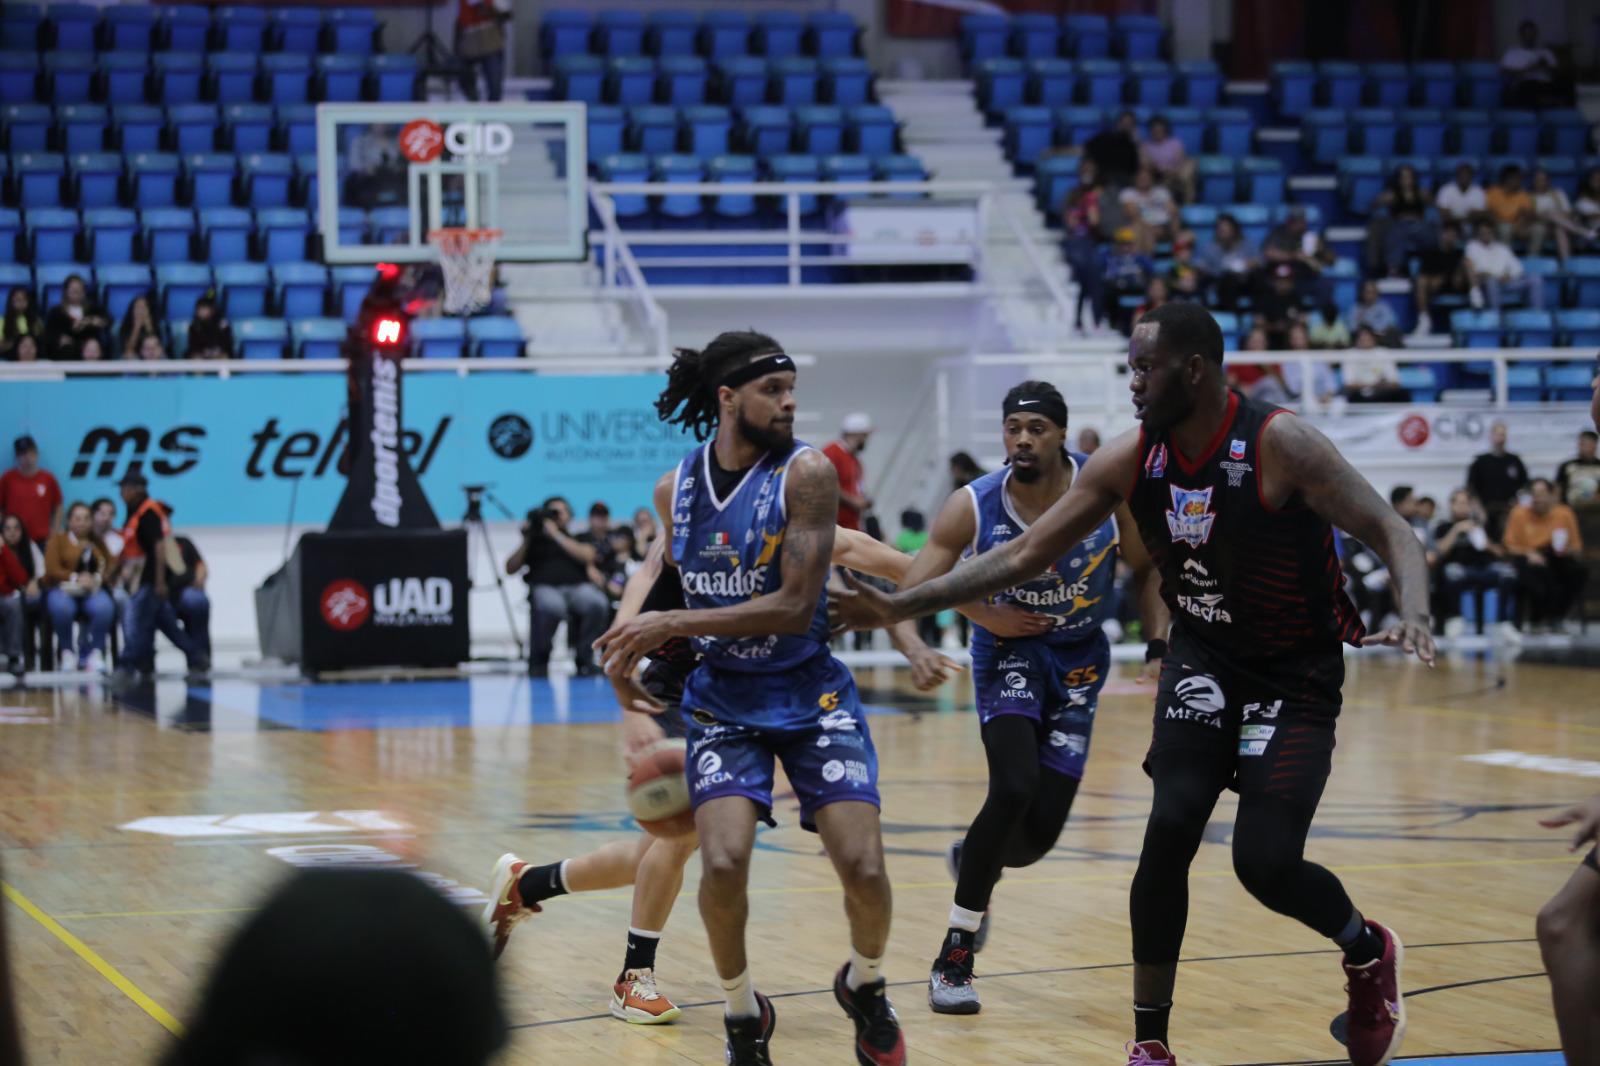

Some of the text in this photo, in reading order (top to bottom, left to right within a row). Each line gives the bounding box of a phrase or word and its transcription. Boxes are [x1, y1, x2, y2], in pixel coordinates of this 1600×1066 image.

[445, 122, 513, 154] CID
[1177, 594, 1232, 623] Flecha
[1000, 688, 1034, 700] MEGA
[694, 771, 734, 792] MEGA
